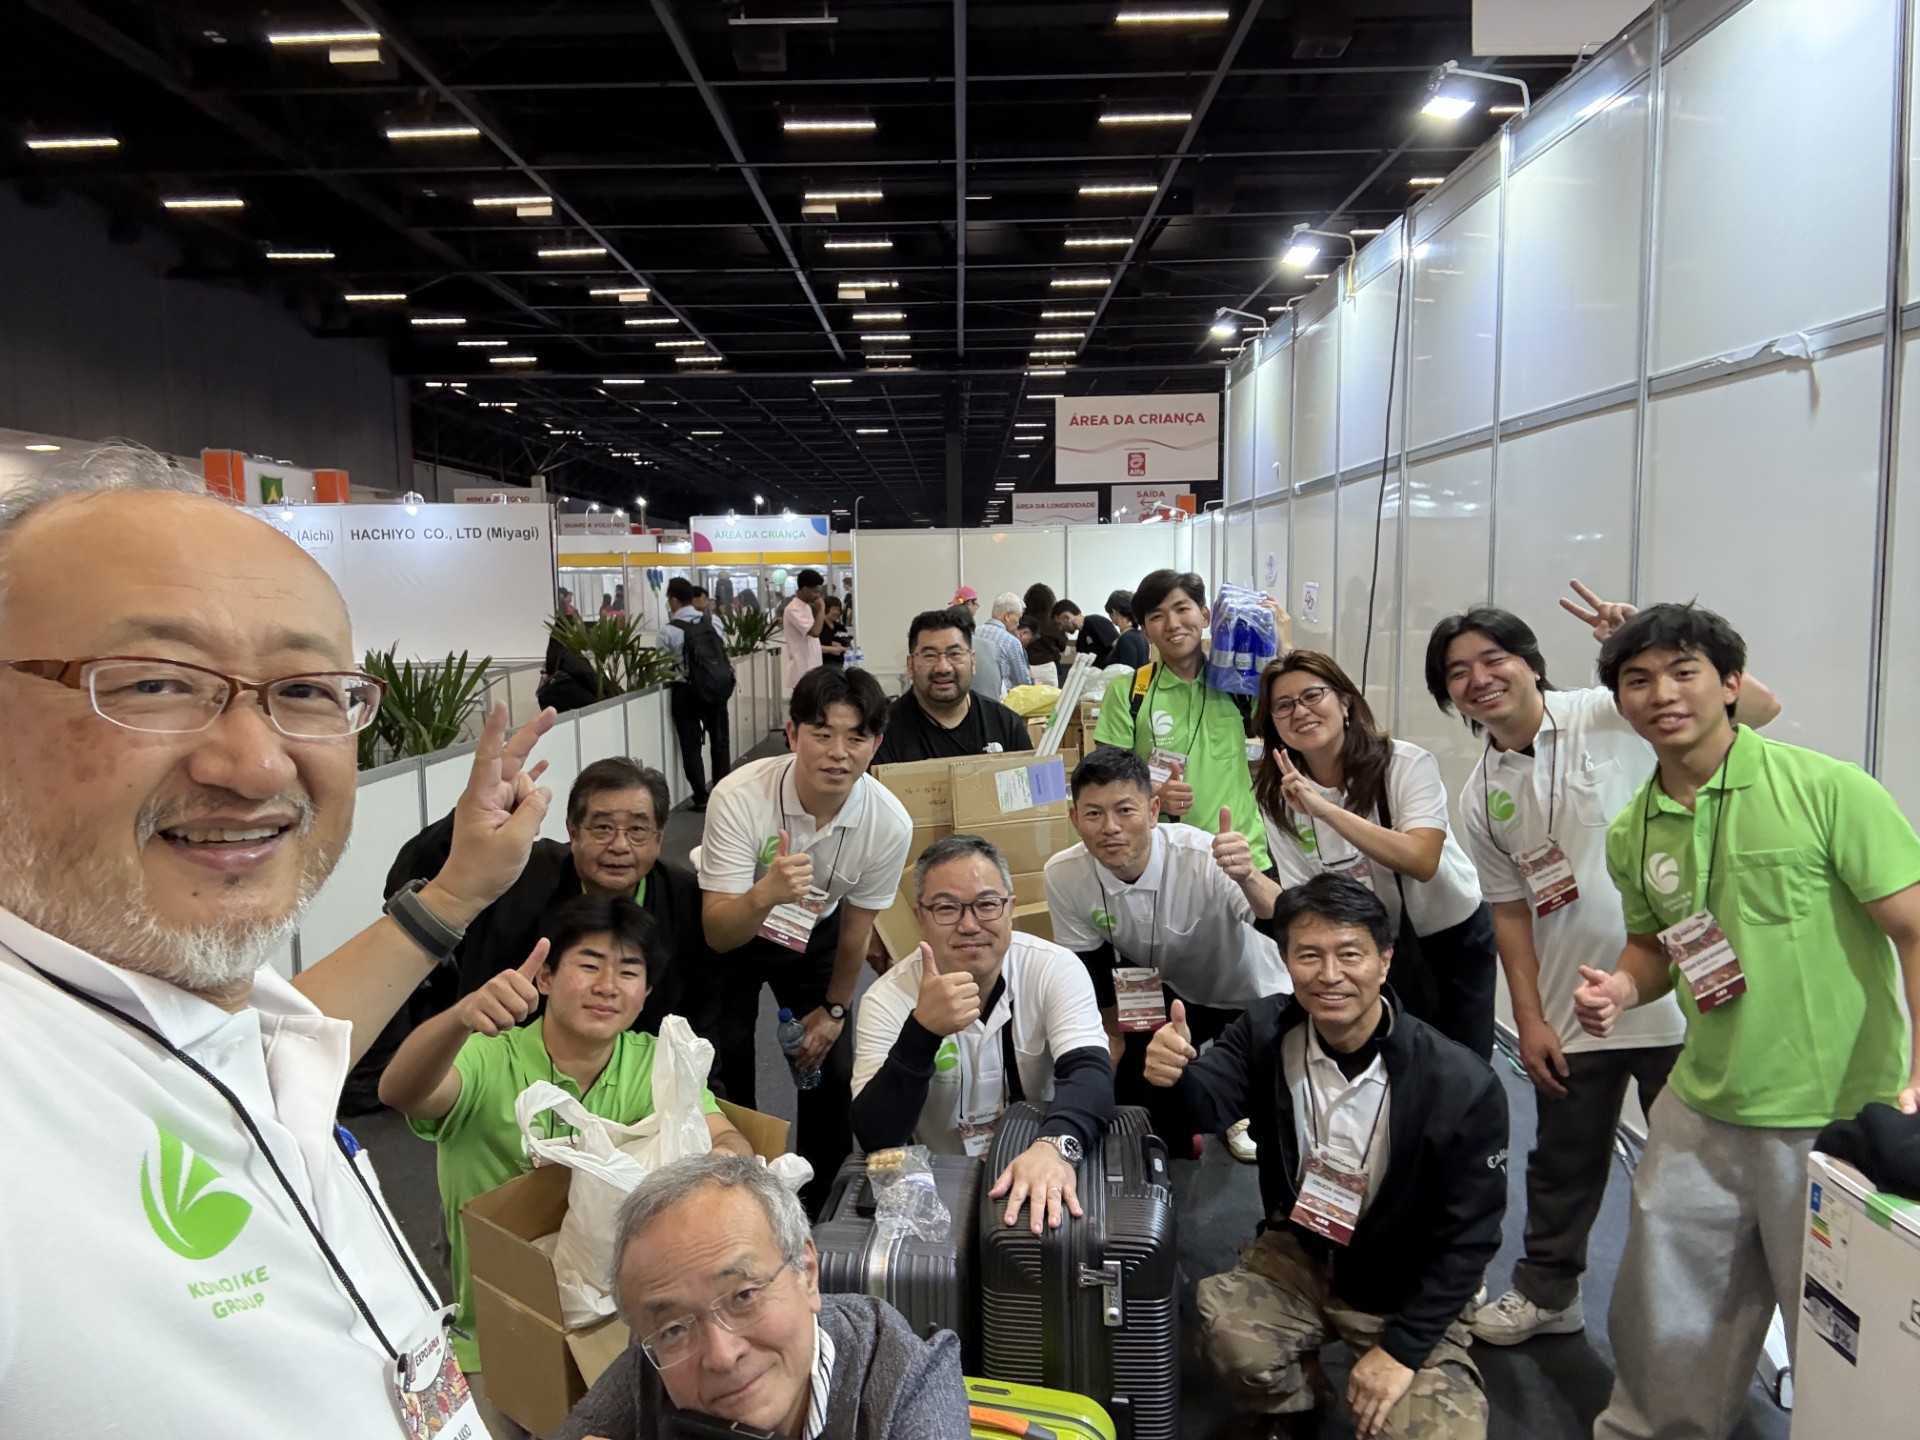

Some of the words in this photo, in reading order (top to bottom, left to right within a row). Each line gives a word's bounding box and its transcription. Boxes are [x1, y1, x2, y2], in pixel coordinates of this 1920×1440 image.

[1069, 413, 1109, 426] ÁREA
[1113, 414, 1135, 425] DA
[1138, 412, 1206, 426] CRIANÇA
[1015, 502, 1034, 510] ÁREA
[297, 529, 334, 544] (Aichi)
[350, 528, 416, 541] HACHIYO
[423, 528, 453, 541] CO.,
[456, 527, 482, 539] LTD
[486, 526, 540, 542] (Miyagi)
[714, 528, 742, 539] ÁREA
[744, 530, 759, 539] DA
[761, 529, 806, 541] CRIANÇA
[187, 1265, 271, 1300] KONOIKE
[212, 1292, 265, 1319] GROUP
